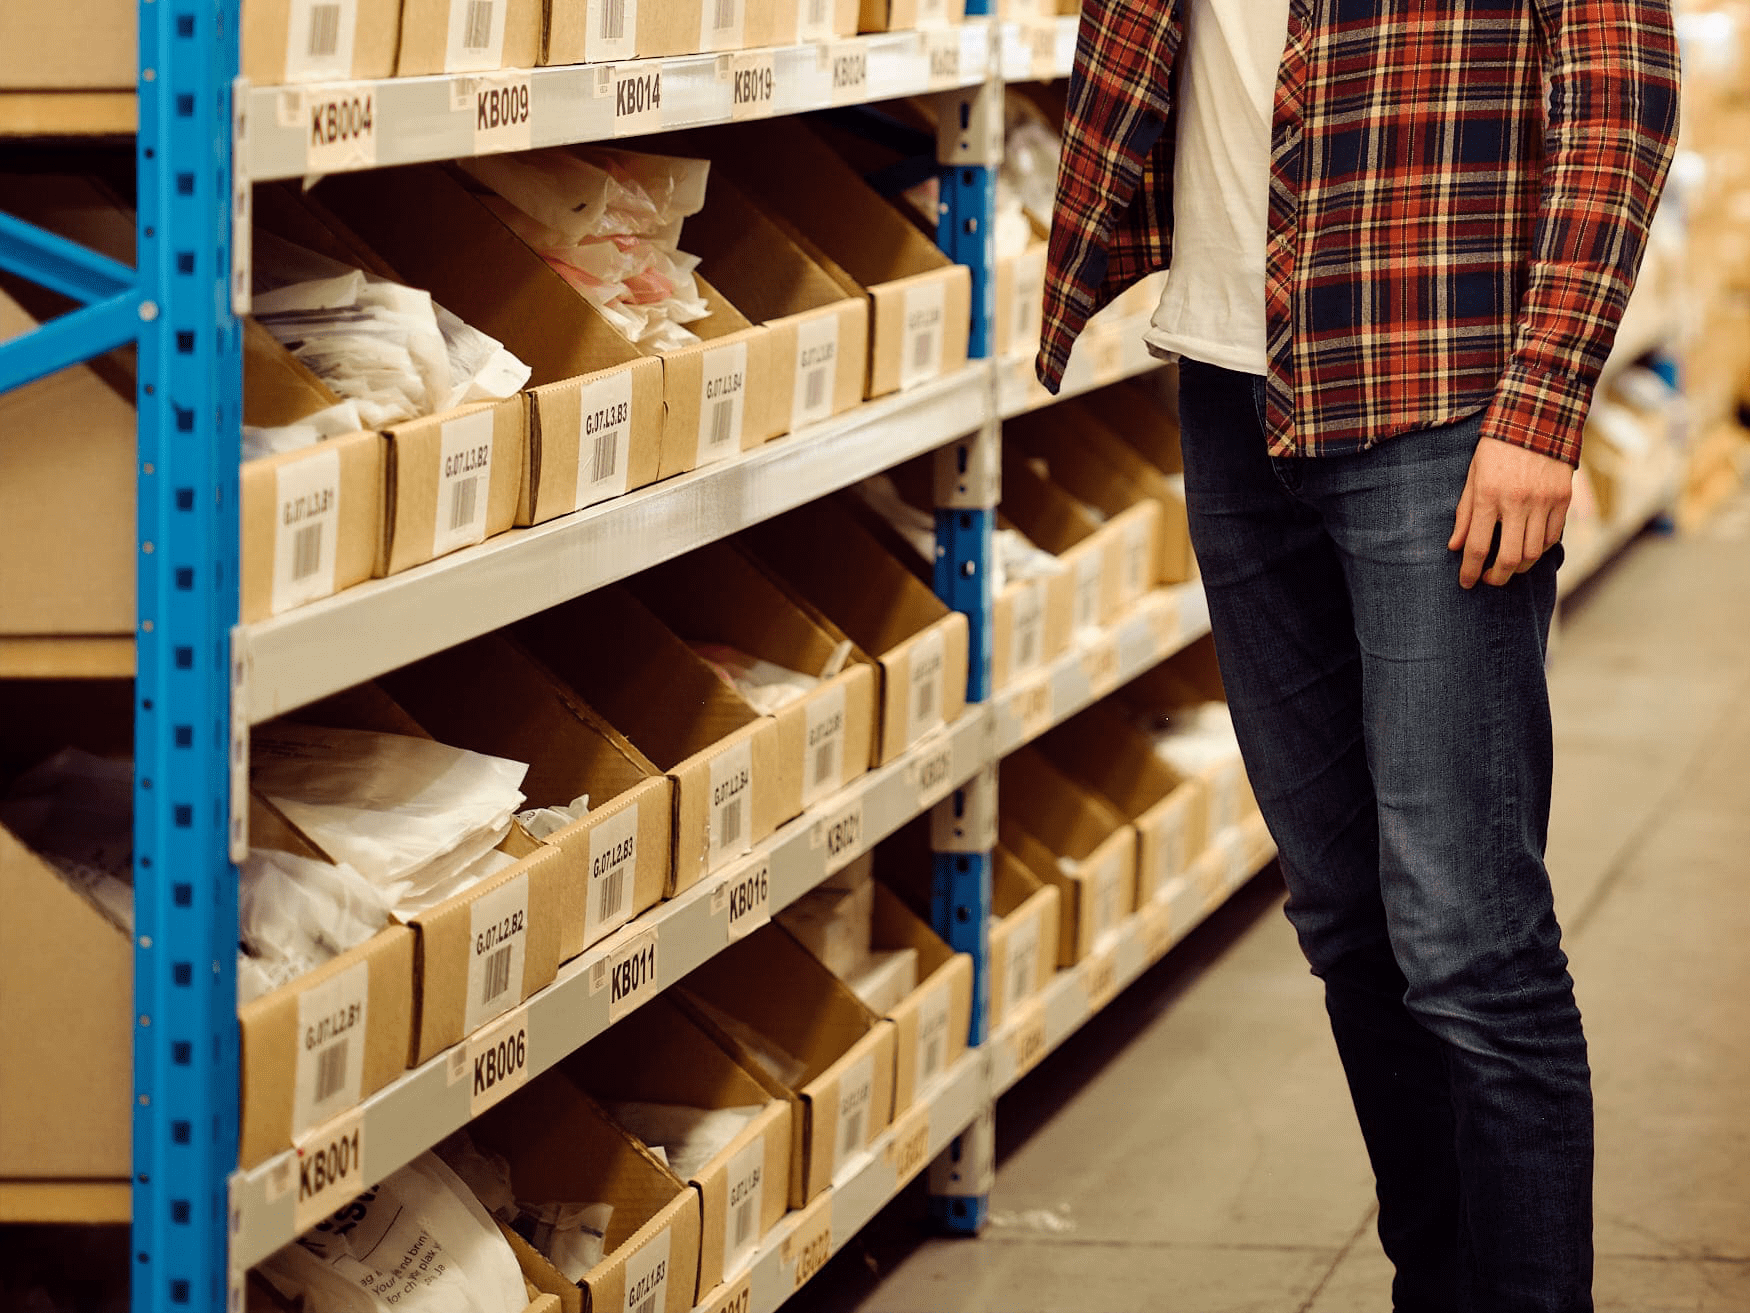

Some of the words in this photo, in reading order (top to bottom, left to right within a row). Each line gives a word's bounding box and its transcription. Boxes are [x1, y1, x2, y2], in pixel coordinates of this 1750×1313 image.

[478, 84, 528, 131] KB009
[615, 73, 661, 118] KB014
[735, 67, 771, 105] KB019
[312, 96, 372, 148] KB004
[586, 402, 628, 436] G.07.L3.B3
[446, 445, 488, 478] G.07.L3.B2
[593, 835, 633, 878] G.07.L2.B3
[728, 867, 768, 924] KB016
[476, 909, 524, 956] G.07.L2.B2
[610, 942, 654, 1005] KB011
[472, 1028, 525, 1097] KB006
[299, 1127, 360, 1203] KB001
[629, 1259, 665, 1309] G.07.L1.B3
